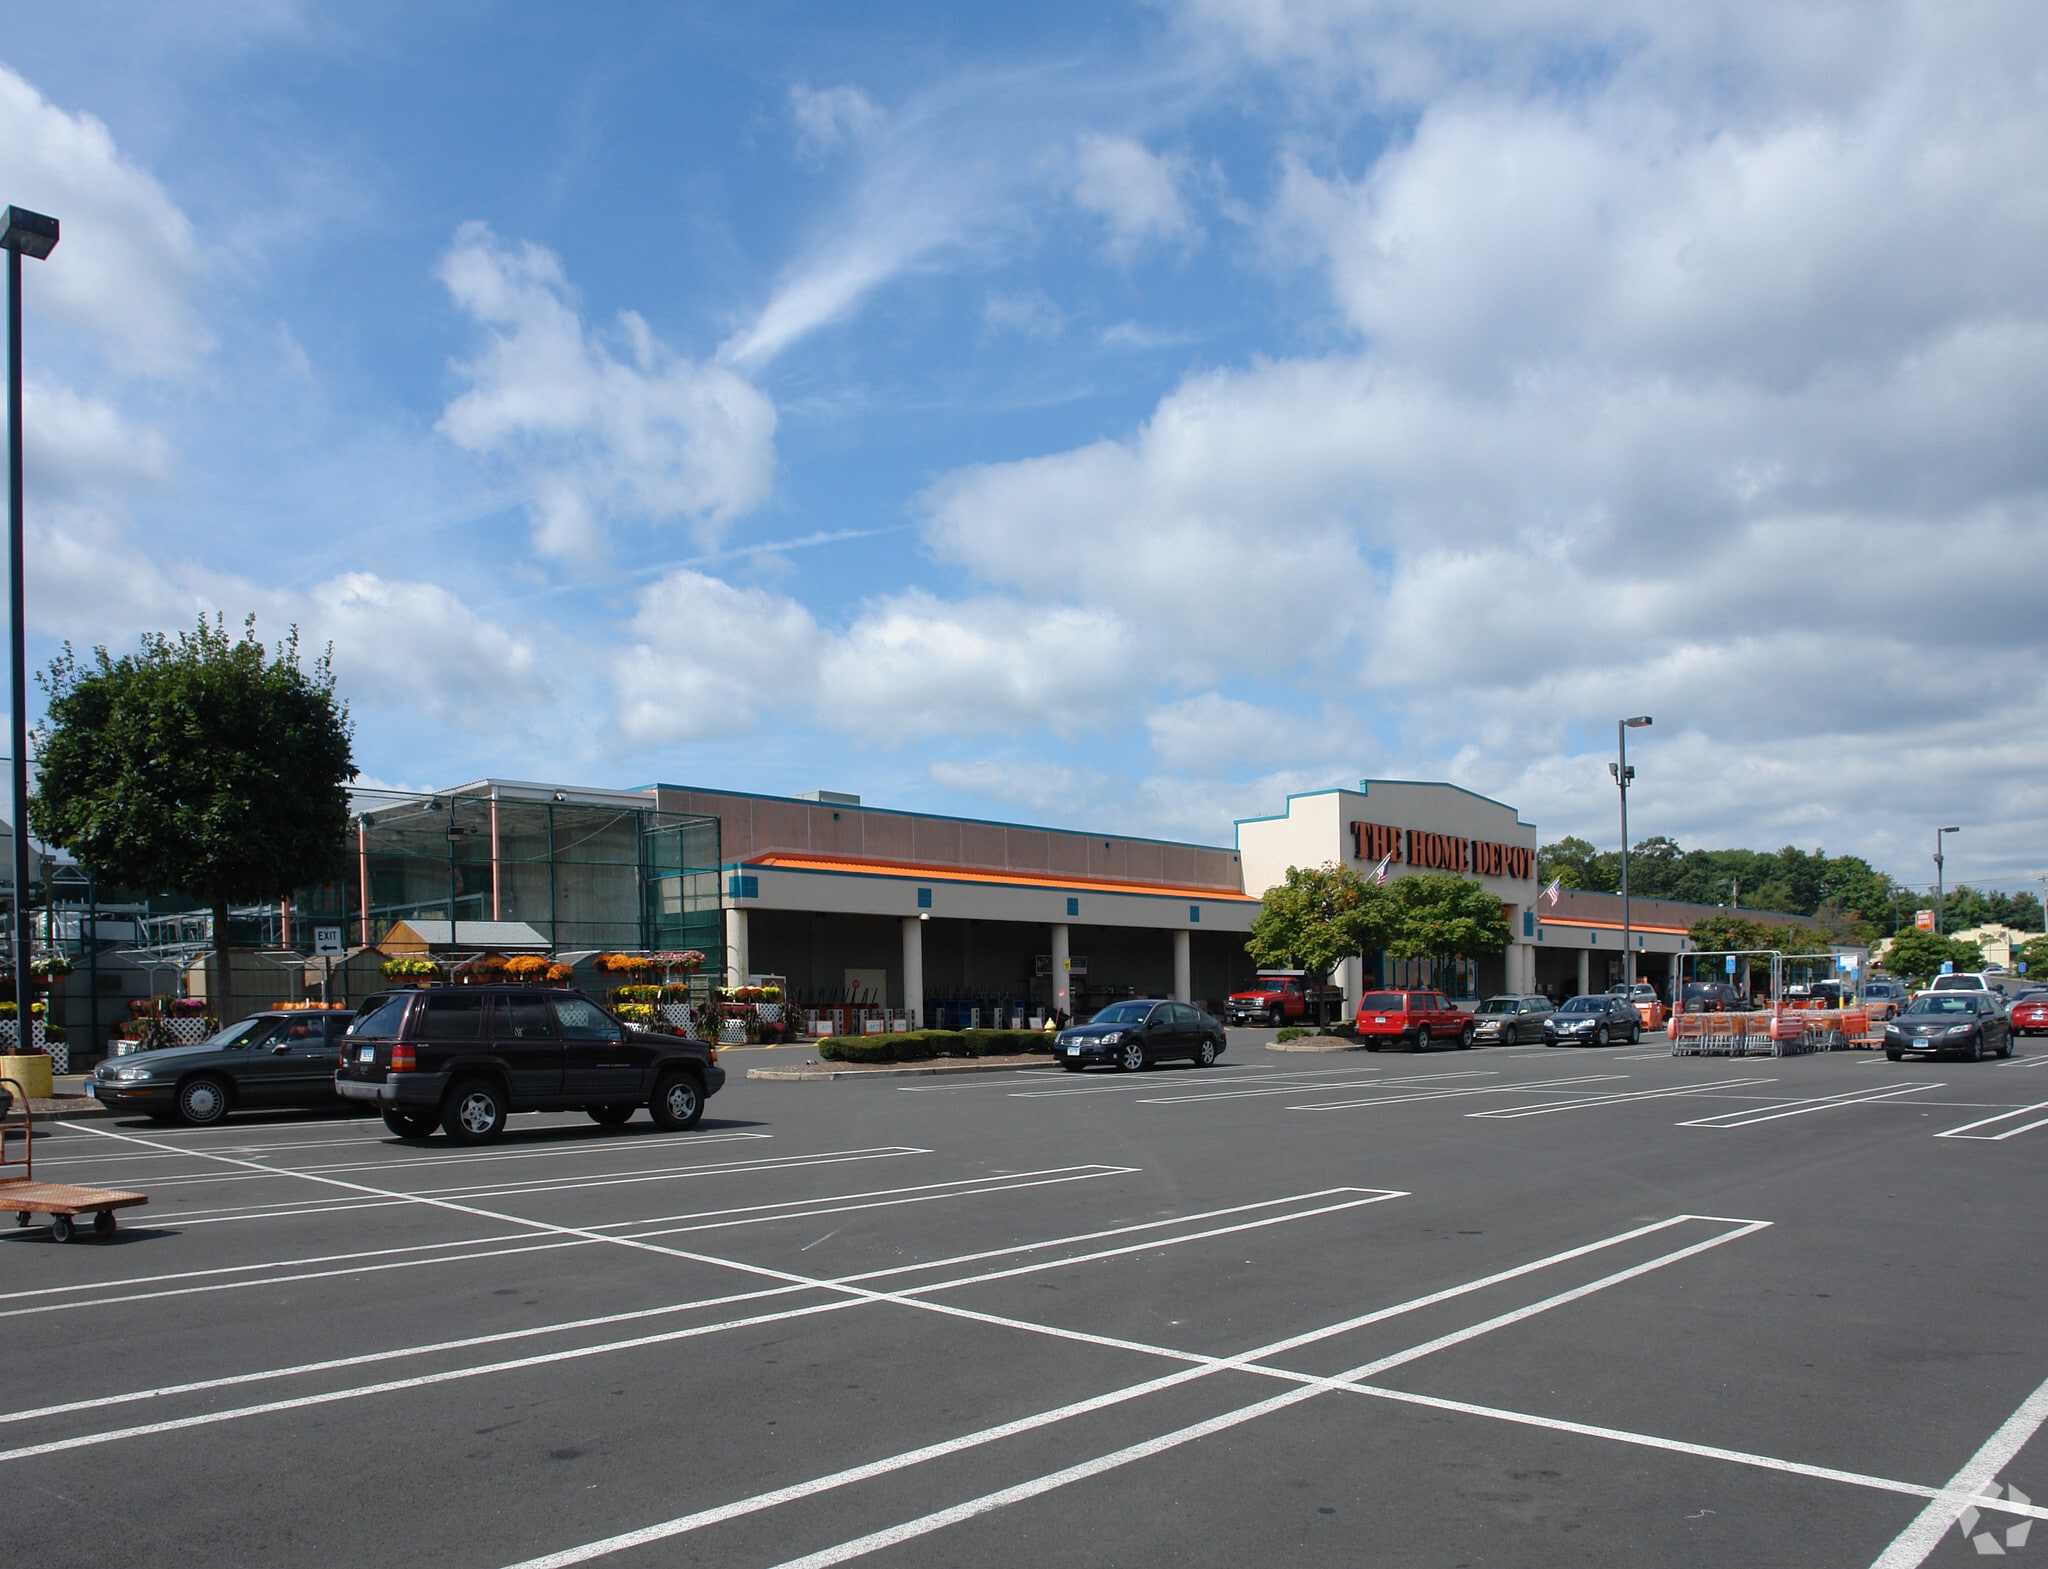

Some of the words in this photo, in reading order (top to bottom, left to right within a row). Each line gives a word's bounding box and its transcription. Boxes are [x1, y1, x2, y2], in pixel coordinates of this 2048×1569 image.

[1350, 821, 1403, 863] THE
[1406, 829, 1470, 871] HOME
[1472, 841, 1535, 879] DEPOT
[318, 931, 337, 940] EXIT
